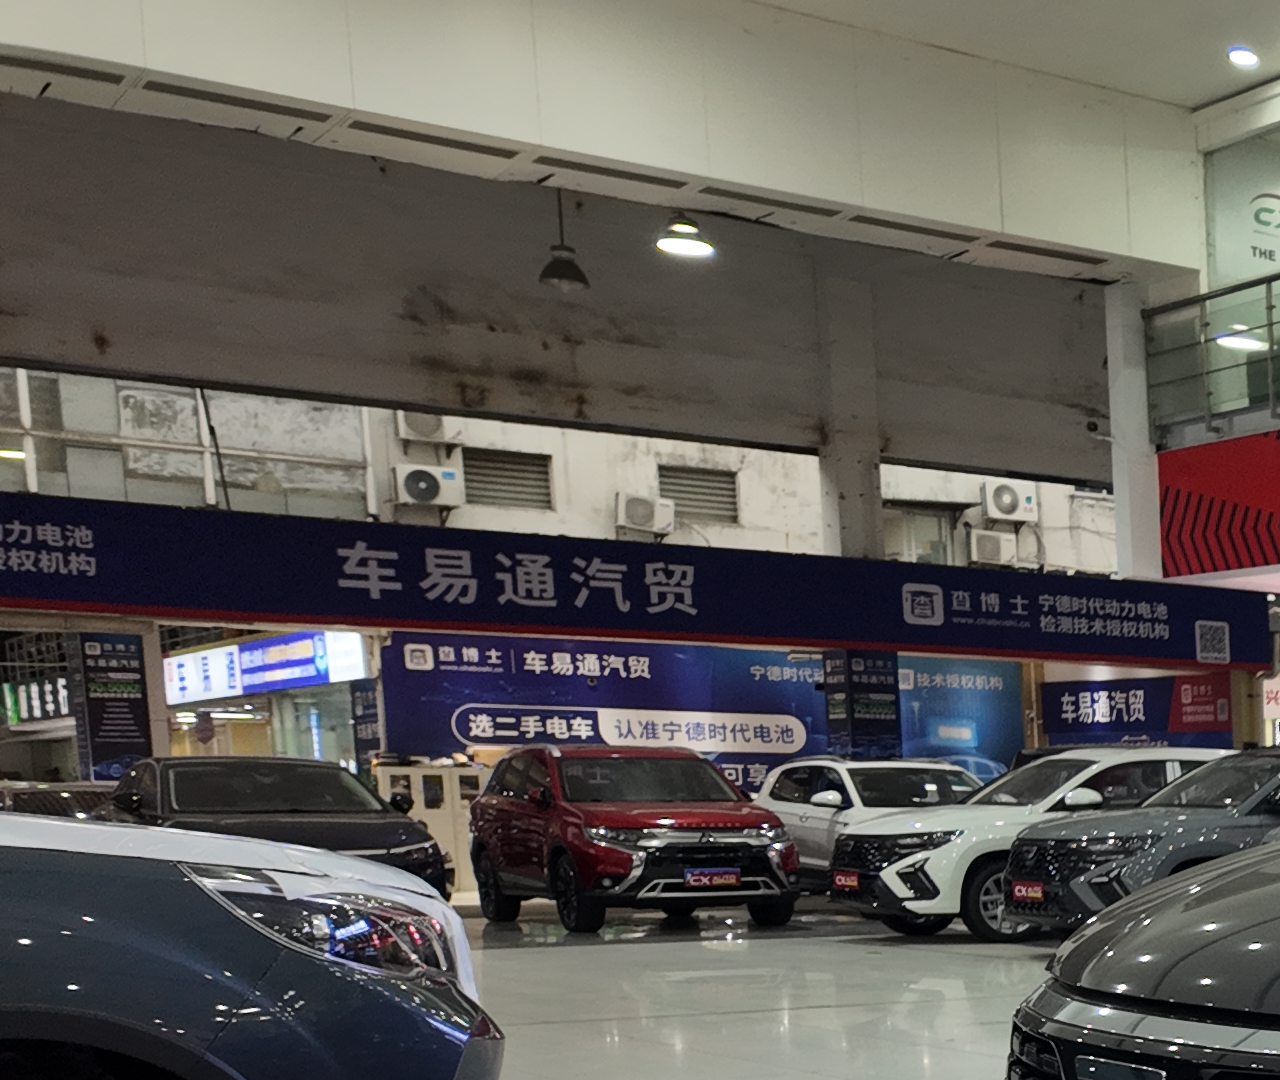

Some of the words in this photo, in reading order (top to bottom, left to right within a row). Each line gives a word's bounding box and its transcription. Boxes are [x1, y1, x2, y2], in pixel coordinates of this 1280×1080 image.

[1250, 245, 1277, 262] THE
[0, 520, 95, 549] 力电池
[336, 540, 699, 616] 车易通汽贸
[1038, 594, 1169, 620] 宁德时代动力电池
[1039, 614, 1170, 641] 检测技术授权机构
[523, 650, 651, 679] 车易通汽贸
[916, 672, 1004, 691] 技术授权机构
[1060, 689, 1145, 724] 车易通汽贸
[468, 714, 594, 740] 选二手电车
[614, 718, 795, 745] 认准宁德时代电池
